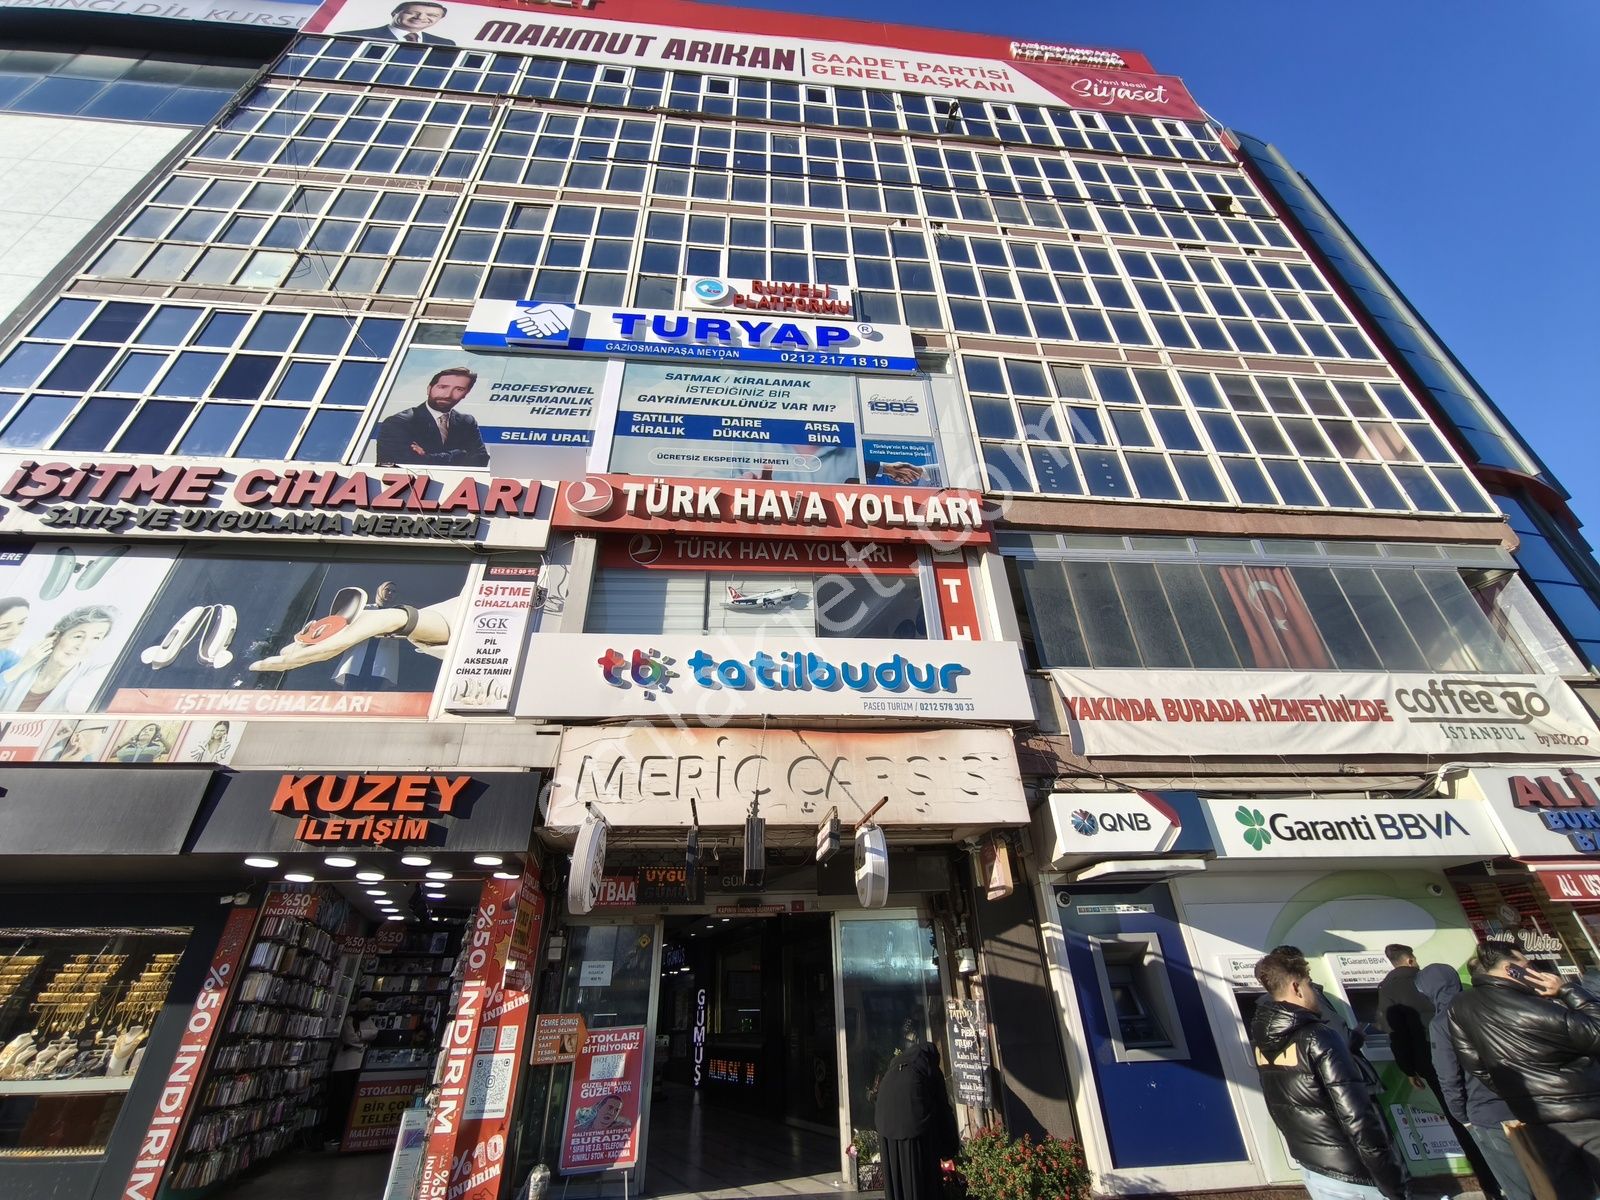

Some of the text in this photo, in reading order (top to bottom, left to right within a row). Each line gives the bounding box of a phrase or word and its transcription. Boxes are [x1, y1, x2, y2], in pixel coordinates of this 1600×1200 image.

[133, 3, 192, 18] DİL
[474, 20, 796, 72] MAHMUT ARIKAN
[811, 51, 1011, 81] SAADET PARTİSİ
[811, 64, 1015, 93] GENEL BAŞKANI
[1071, 78, 1169, 106] Siyaset
[733, 293, 850, 315] PLATFORMU
[612, 313, 850, 348] TURYAP
[605, 341, 740, 359] GAZİOSMANPAŞA MEYDAN
[781, 353, 889, 368] 0212 217 18 19
[665, 372, 722, 383] SATMAK
[733, 375, 811, 388] KİRALAMAK
[491, 383, 595, 394] PROFESYONEL
[685, 383, 791, 398] İSTEDİĞİNİZ BİR
[489, 394, 594, 405] DANIŞMANLIK
[637, 394, 837, 413] GAYRİMENKULÜNÜZ VAR MI?
[868, 401, 919, 413] 1985
[530, 405, 592, 417] HİZMETİ
[632, 413, 685, 424] SATILIK
[630, 423, 686, 436] KİRALIK
[721, 416, 762, 428] DAİRE
[804, 422, 840, 432] ARSA
[501, 430, 590, 443] SELİM URAL
[713, 428, 770, 440] DÜKKAN
[808, 431, 841, 444] BİNA
[656, 452, 789, 466] ÜCRETSİZ EKSPERTİZ HİZMETİ
[0, 460, 543, 516] İŞİTME CİHAZLARI
[623, 478, 983, 528] TÜRK HAVA YOLLARI
[39, 506, 480, 539] SATIŞ VE UYGULAMA MERKEZİ
[674, 537, 893, 563] TÜRK HAVA YOLLARI
[479, 584, 532, 598] İŞİTME
[474, 599, 533, 609] CİHAZLARI
[477, 617, 510, 629] SGK
[484, 637, 497, 645] PİL
[456, 667, 512, 676] CİHAZ TAMİRİ
[687, 650, 966, 694] tatilbudur
[175, 694, 372, 714] İŞİTME CİHAZLARI
[863, 702, 885, 711] PASEO
[920, 702, 938, 711] 0212
[940, 702, 953, 711] 578
[955, 703, 964, 711] 30
[966, 703, 975, 711] 33
[1062, 693, 1394, 722] YAKINDA BURADA HİZMETİNİZDE
[1395, 679, 1551, 724] coffee go
[1440, 724, 1526, 741] İSTANBUL
[269, 775, 472, 813] KUZEY
[1508, 767, 1600, 809] ALİ
[294, 814, 430, 845] İLETİŞİM
[1099, 813, 1152, 832] QNB
[1269, 810, 1471, 842] Garanti BBVA
[645, 869, 687, 882] UYGU
[596, 880, 637, 902] TBAA
[281, 893, 312, 907] %50
[265, 907, 307, 916] İNDİRİM
[469, 904, 496, 969] %50
[1518, 928, 1563, 951] Usta
[1347, 956, 1368, 966] Garanti
[188, 962, 230, 1034] %50
[482, 993, 530, 1023] İNDİRİM
[540, 1018, 559, 1027] CEMRE
[585, 1031, 640, 1045] STOKLARI
[582, 1041, 639, 1054] BİTİRİYORUZ
[434, 981, 486, 1134] İNDİRİM
[360, 1085, 411, 1097] STOKLARI
[613, 1084, 631, 1094] PARA
[363, 1101, 384, 1112] BİR
[571, 1134, 631, 1146] BURADA
